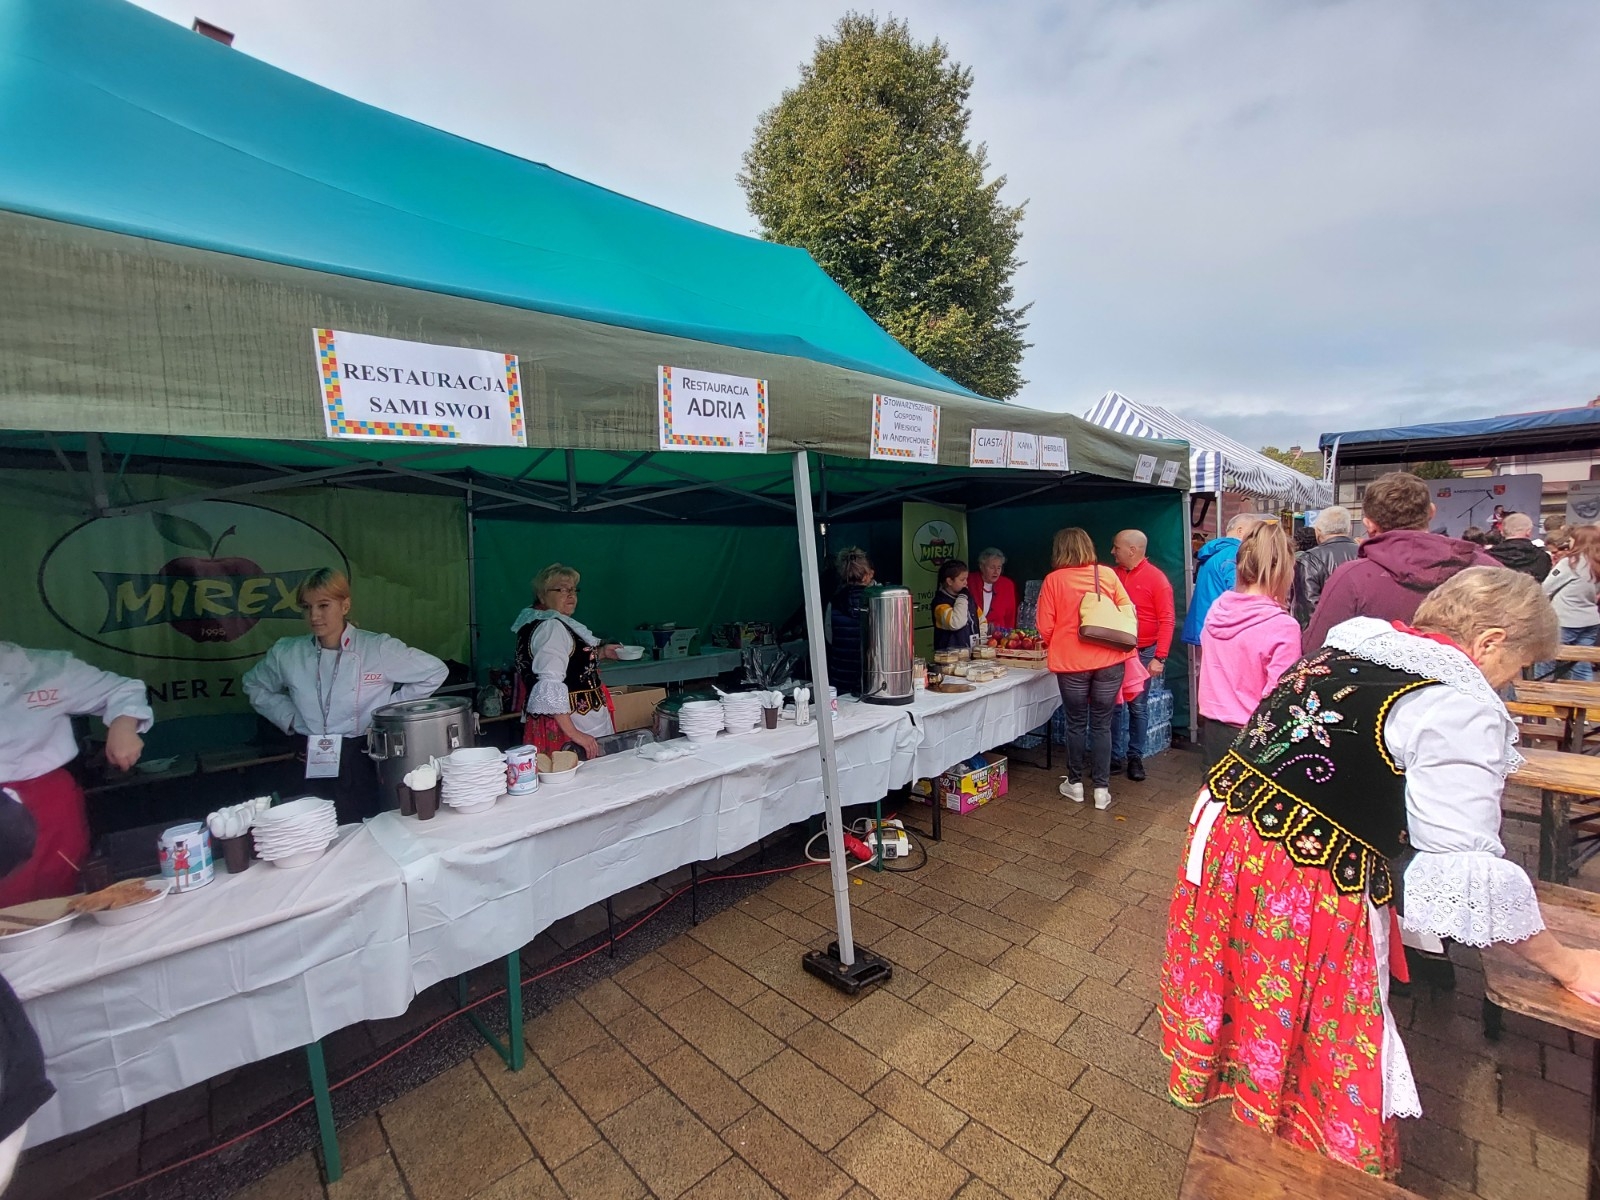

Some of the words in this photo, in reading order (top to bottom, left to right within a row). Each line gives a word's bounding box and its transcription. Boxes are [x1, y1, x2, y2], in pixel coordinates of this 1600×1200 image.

[342, 362, 506, 393] RESTAURACJA
[682, 376, 750, 396] RESTAURACJA
[369, 396, 428, 416] SAMI
[435, 403, 491, 420] SWOI
[687, 397, 746, 420] ADRIA
[977, 437, 1004, 447] CIASTA
[1017, 441, 1033, 450] KAWA
[921, 545, 954, 559] MIREX
[116, 578, 304, 623] MIREX
[917, 589, 934, 600] TWÓJ
[200, 627, 226, 637] 1995
[364, 673, 382, 681] ZDZ
[24, 688, 59, 703] ZDZ
[148, 679, 208, 706] NER
[218, 677, 236, 697] Z
